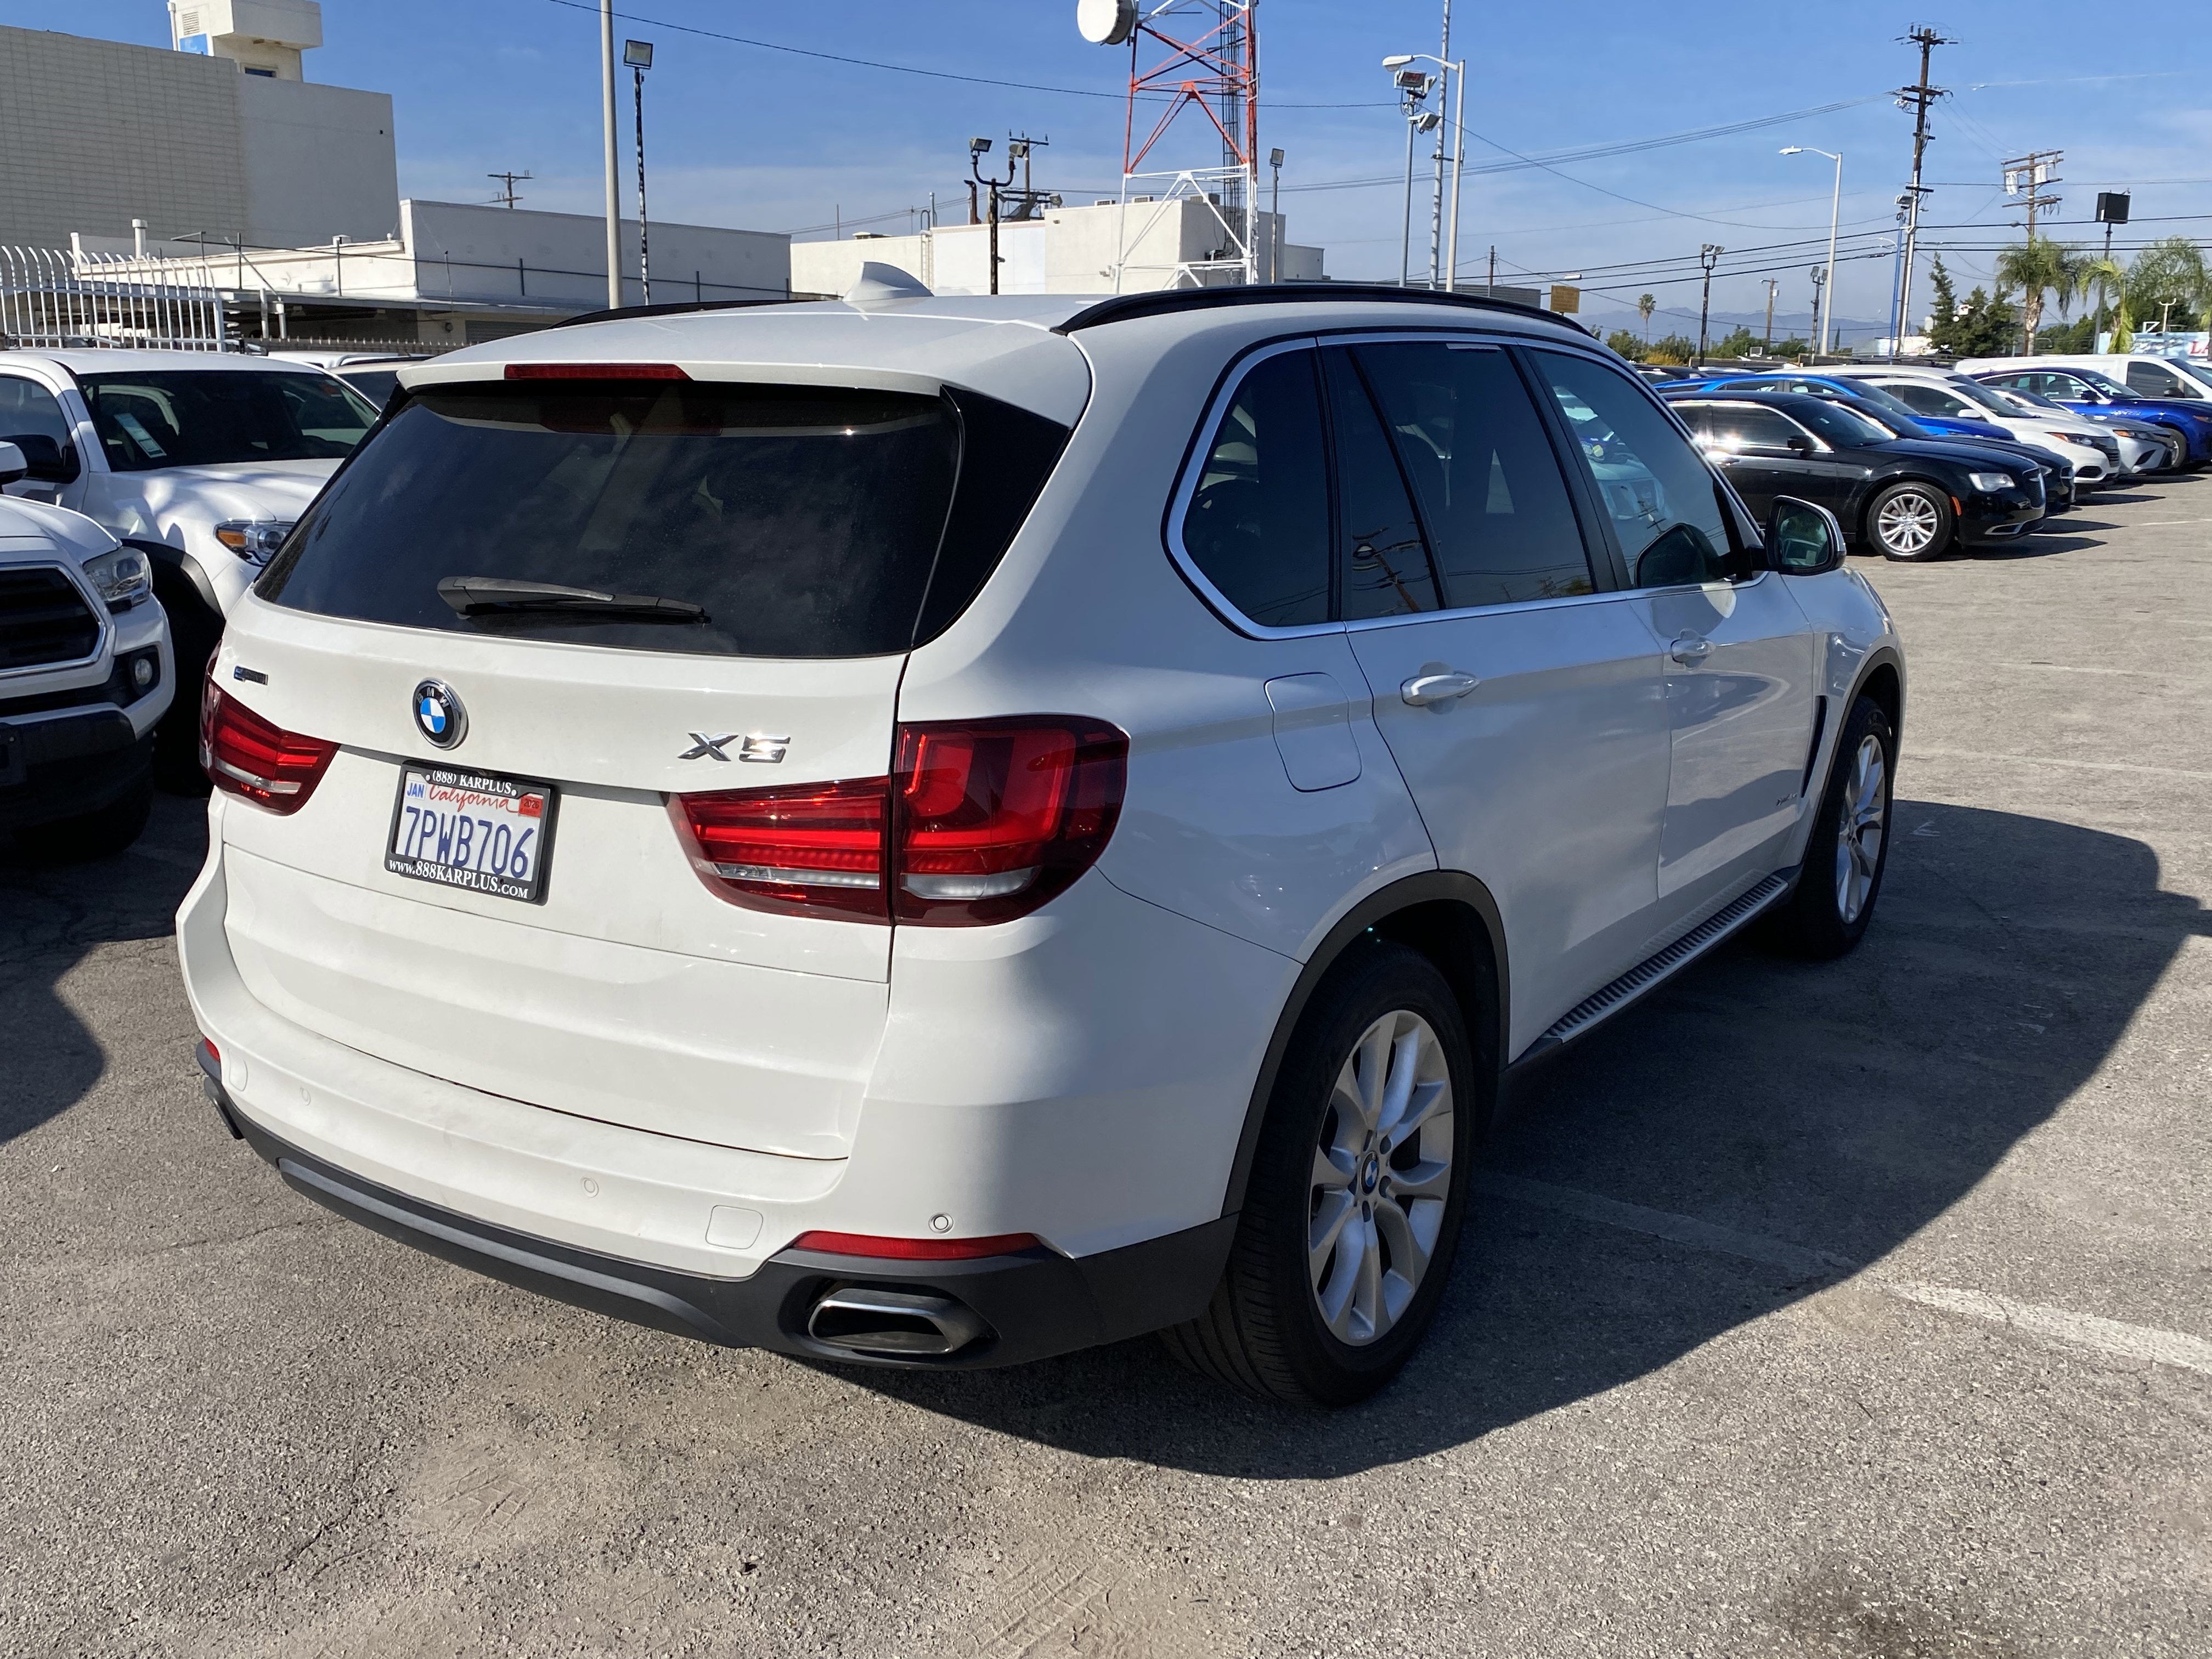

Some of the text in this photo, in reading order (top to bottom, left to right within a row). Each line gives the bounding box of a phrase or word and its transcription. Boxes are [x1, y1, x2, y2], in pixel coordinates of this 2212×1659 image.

[417, 686, 450, 708] BMW
[677, 731, 791, 763] X5
[407, 782, 425, 798] JAN
[432, 770, 457, 785] (888)
[430, 784, 519, 813] California
[404, 805, 534, 878] 7PWB706
